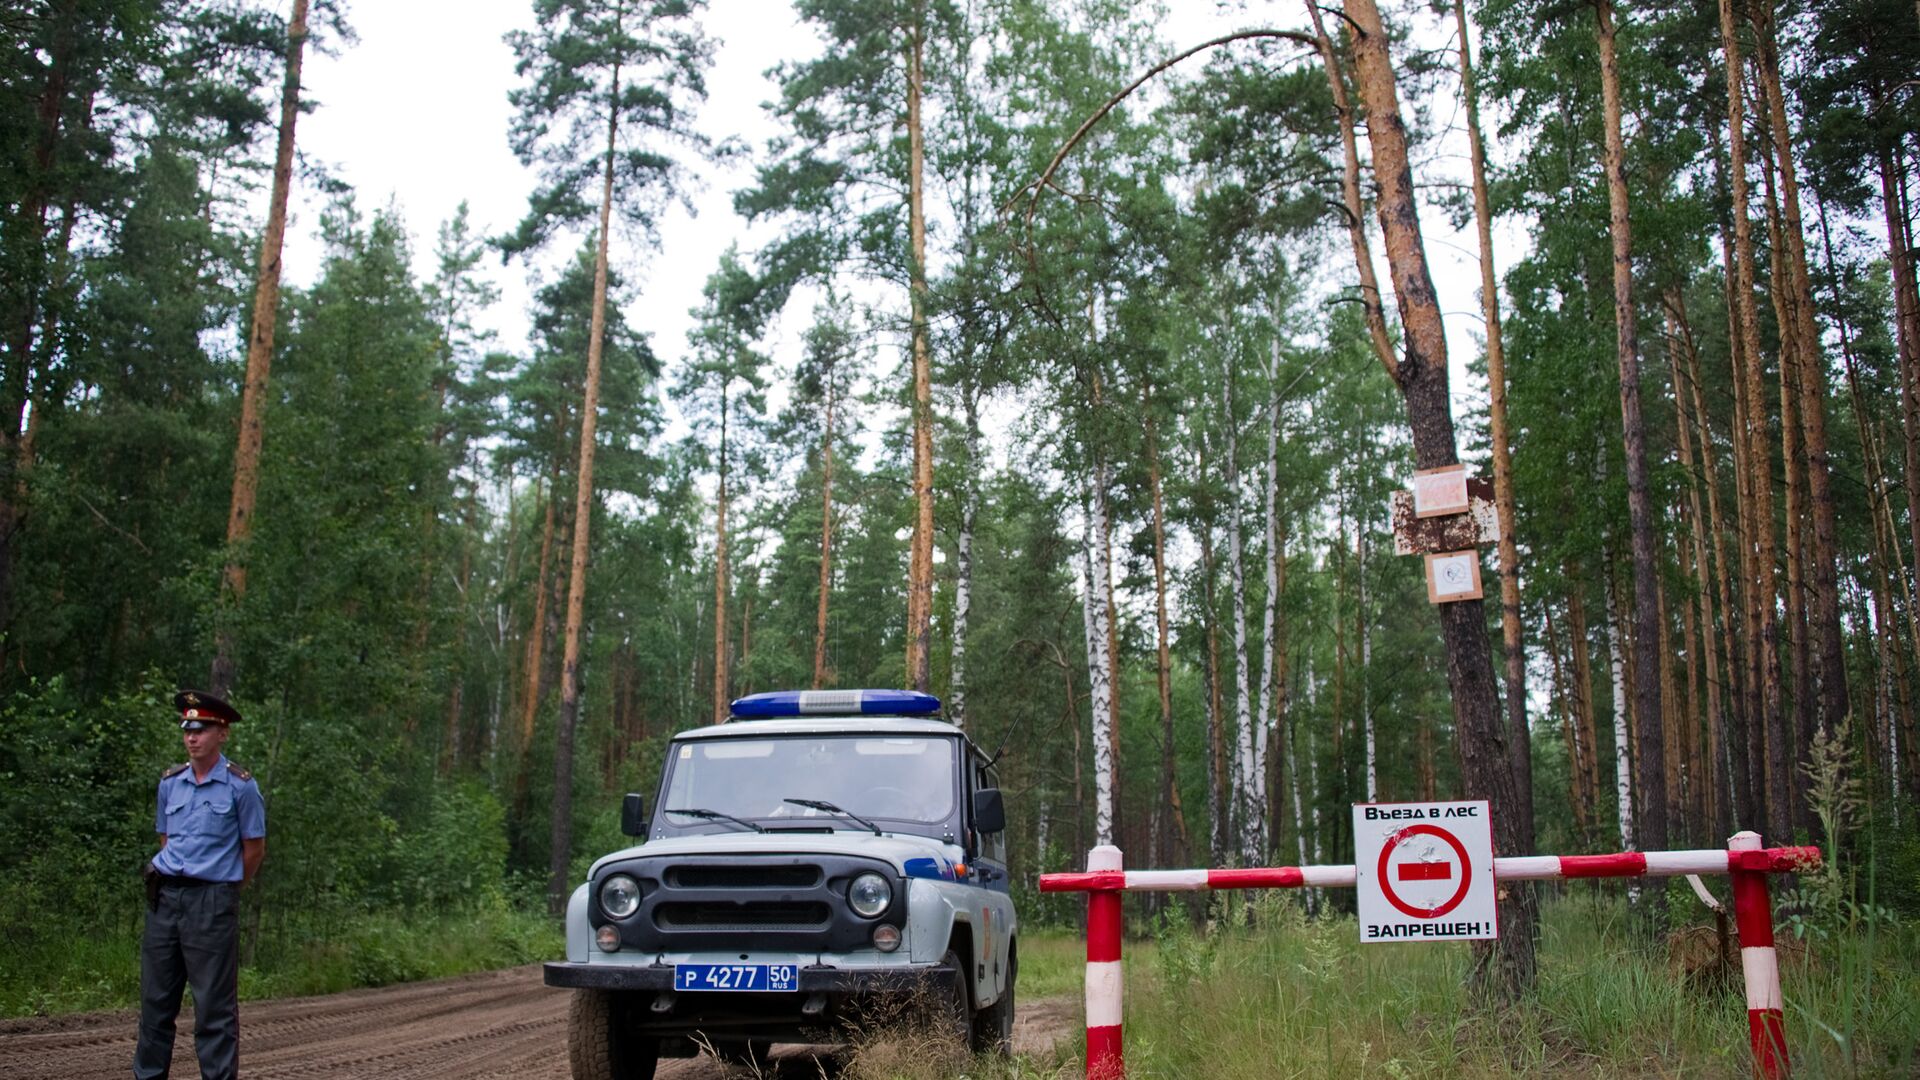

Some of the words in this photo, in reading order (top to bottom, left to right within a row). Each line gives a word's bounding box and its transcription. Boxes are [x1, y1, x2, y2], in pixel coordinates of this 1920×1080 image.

[1365, 807, 1425, 820] Въезд
[1429, 808, 1440, 818] в
[1445, 806, 1478, 818] лес
[706, 967, 757, 988] 4277
[770, 966, 791, 982] 50
